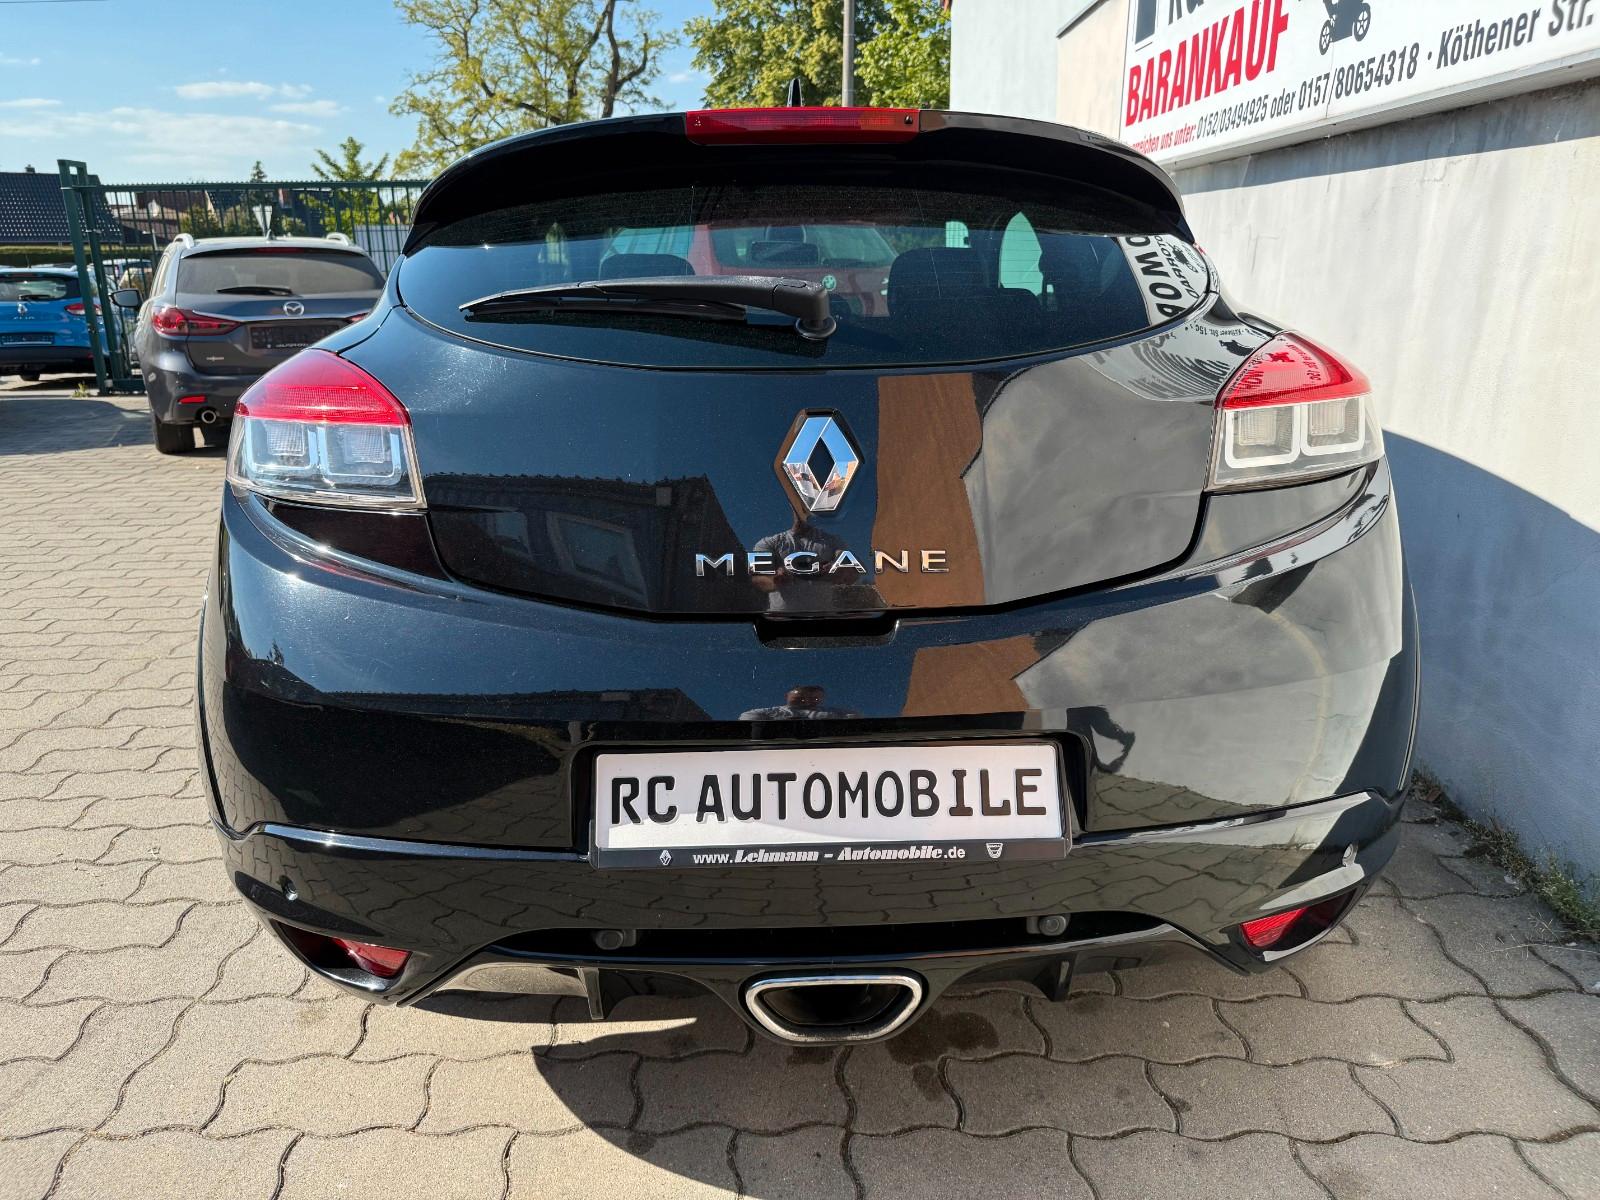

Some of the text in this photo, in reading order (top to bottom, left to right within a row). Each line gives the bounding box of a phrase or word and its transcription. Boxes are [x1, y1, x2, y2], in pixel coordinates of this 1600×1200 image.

[1125, 0, 1289, 127] BARANKAUF
[1196, 94, 1270, 138] 0152/03494925
[1270, 88, 1297, 119] oder
[1298, 42, 1420, 111] 0157/80654318
[1436, 8, 1542, 70] Köthener
[1548, 0, 1594, 37] Str.
[695, 549, 950, 577] MEGANE
[611, 767, 1047, 825] RC AUTOMOBILE
[692, 848, 819, 865] www.Lehmann
[837, 845, 967, 862] Automobile.de
